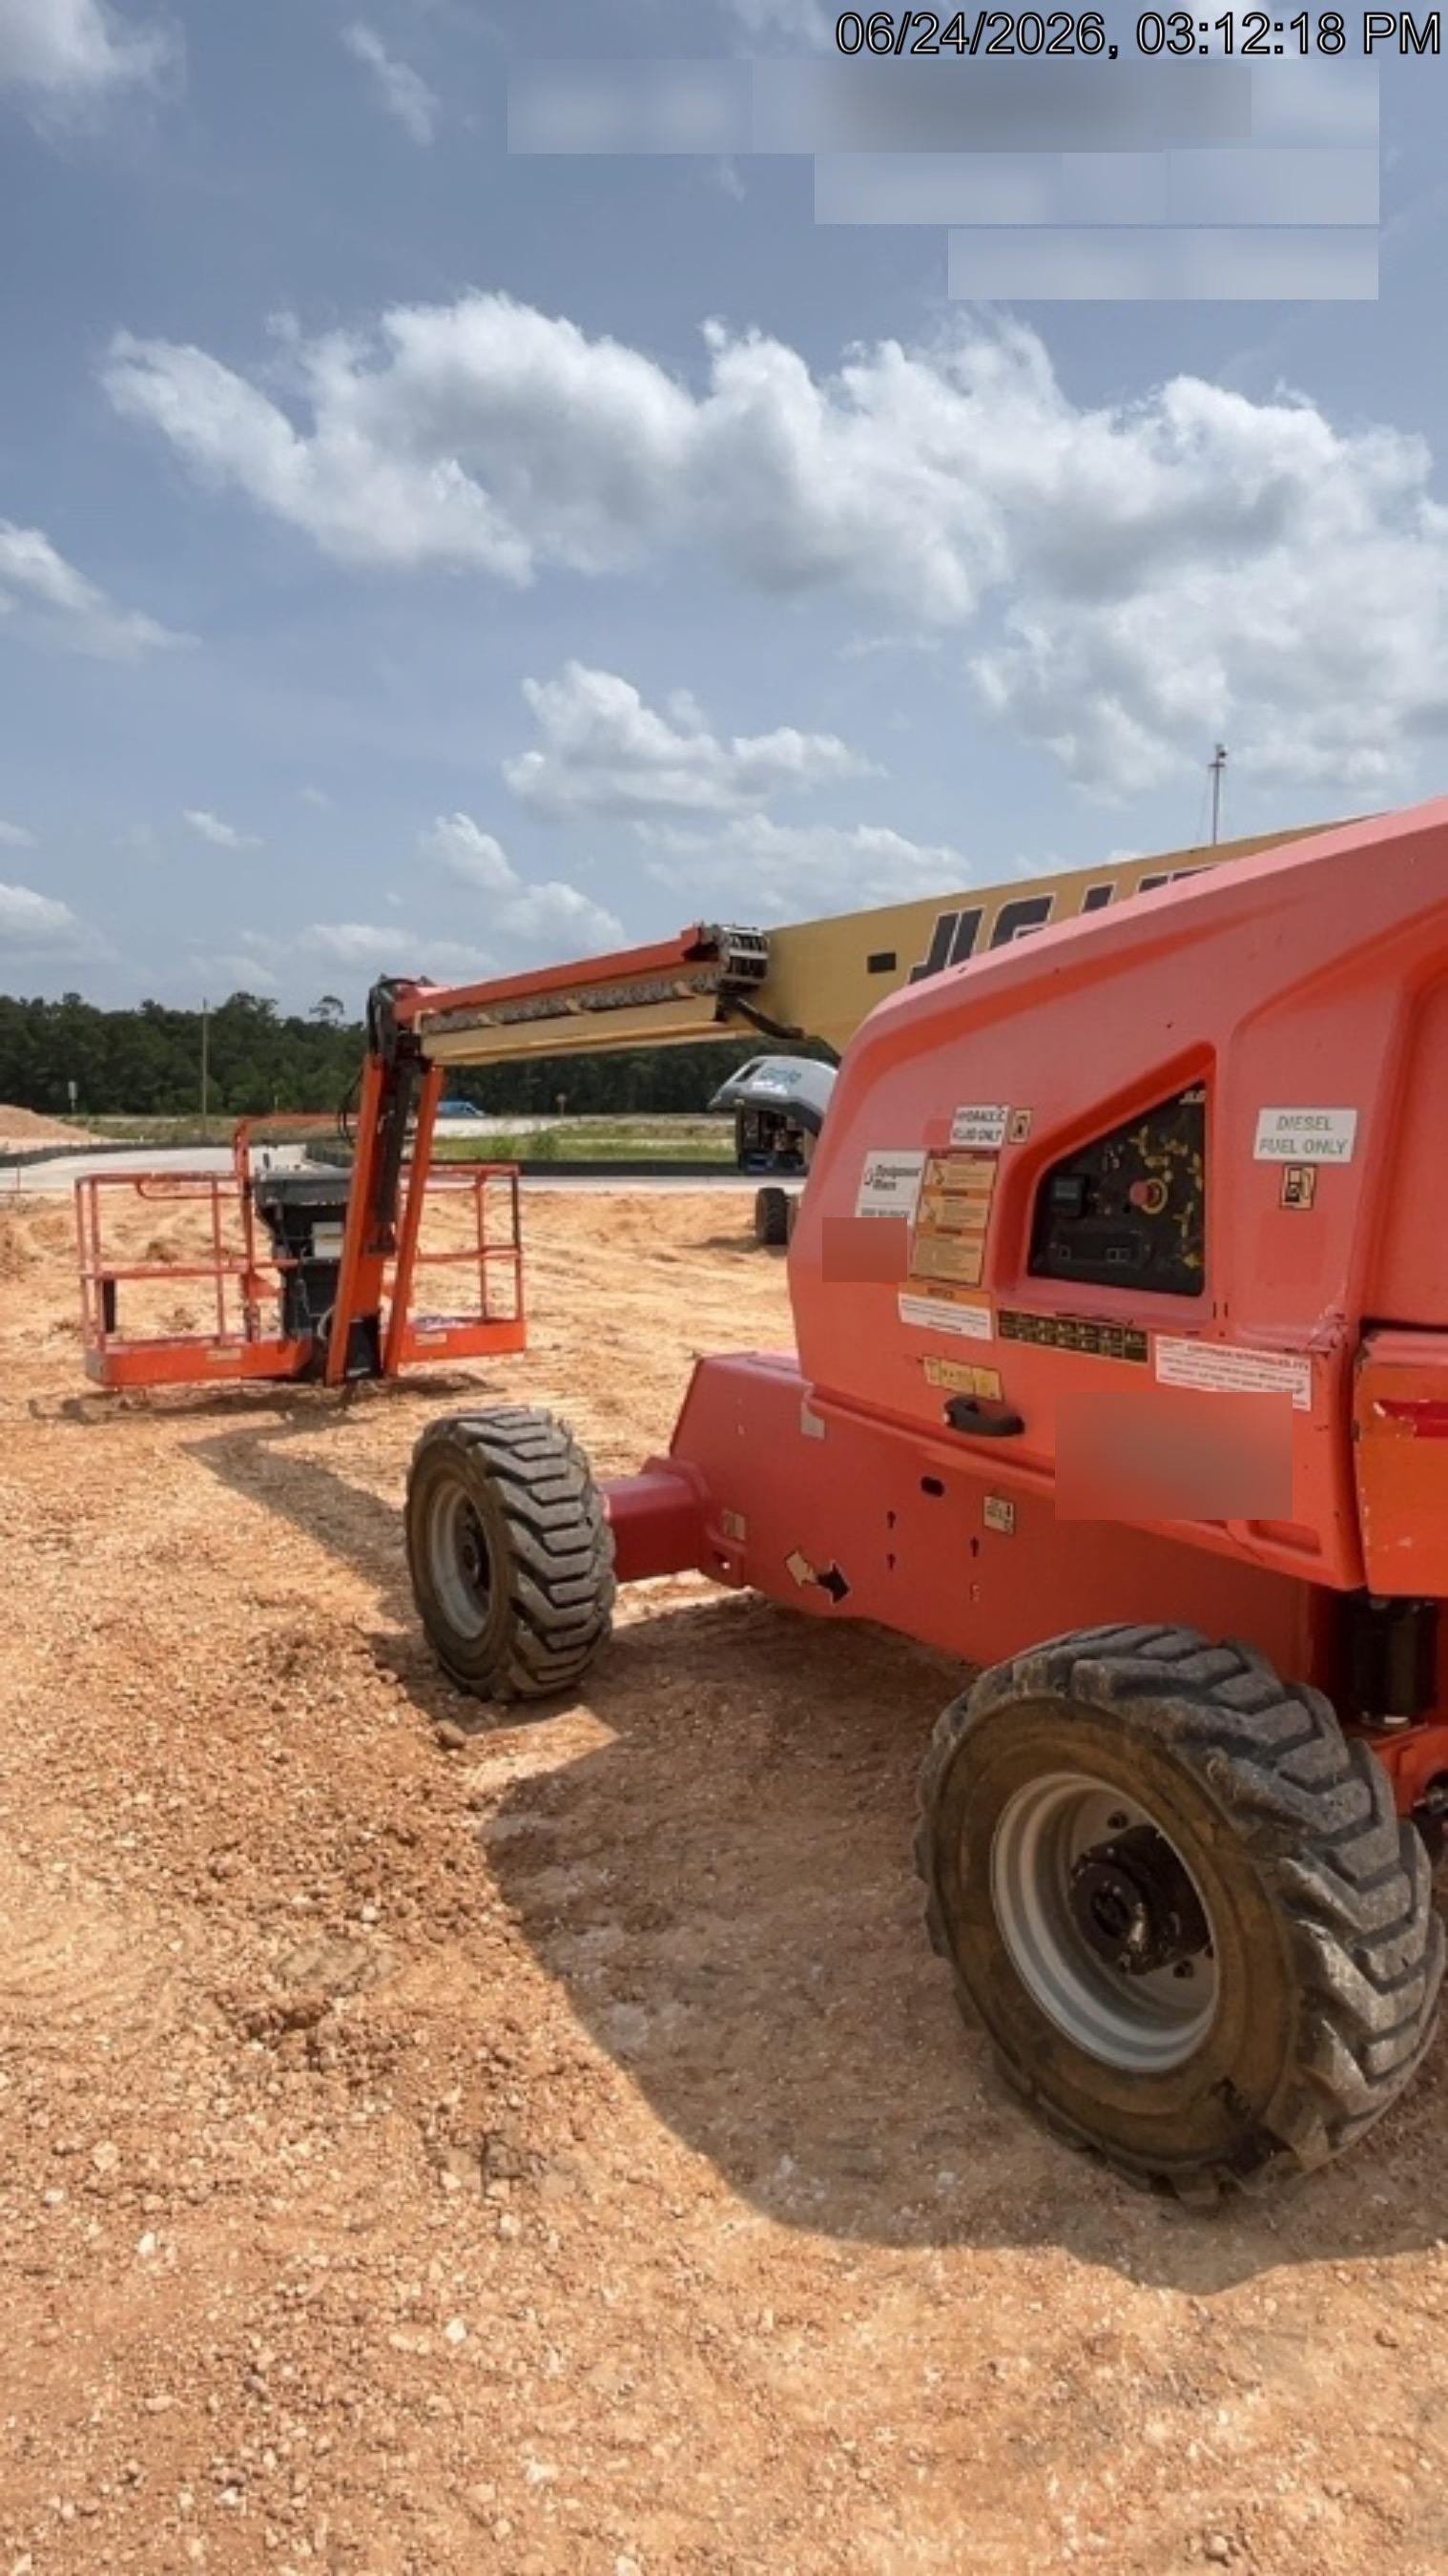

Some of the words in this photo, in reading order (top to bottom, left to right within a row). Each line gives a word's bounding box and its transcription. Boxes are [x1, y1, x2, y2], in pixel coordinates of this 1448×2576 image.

[1276, 1114, 1334, 1131] DIESEL
[1259, 1138, 1297, 1154] FUEL
[1302, 1138, 1348, 1154] ONLY
